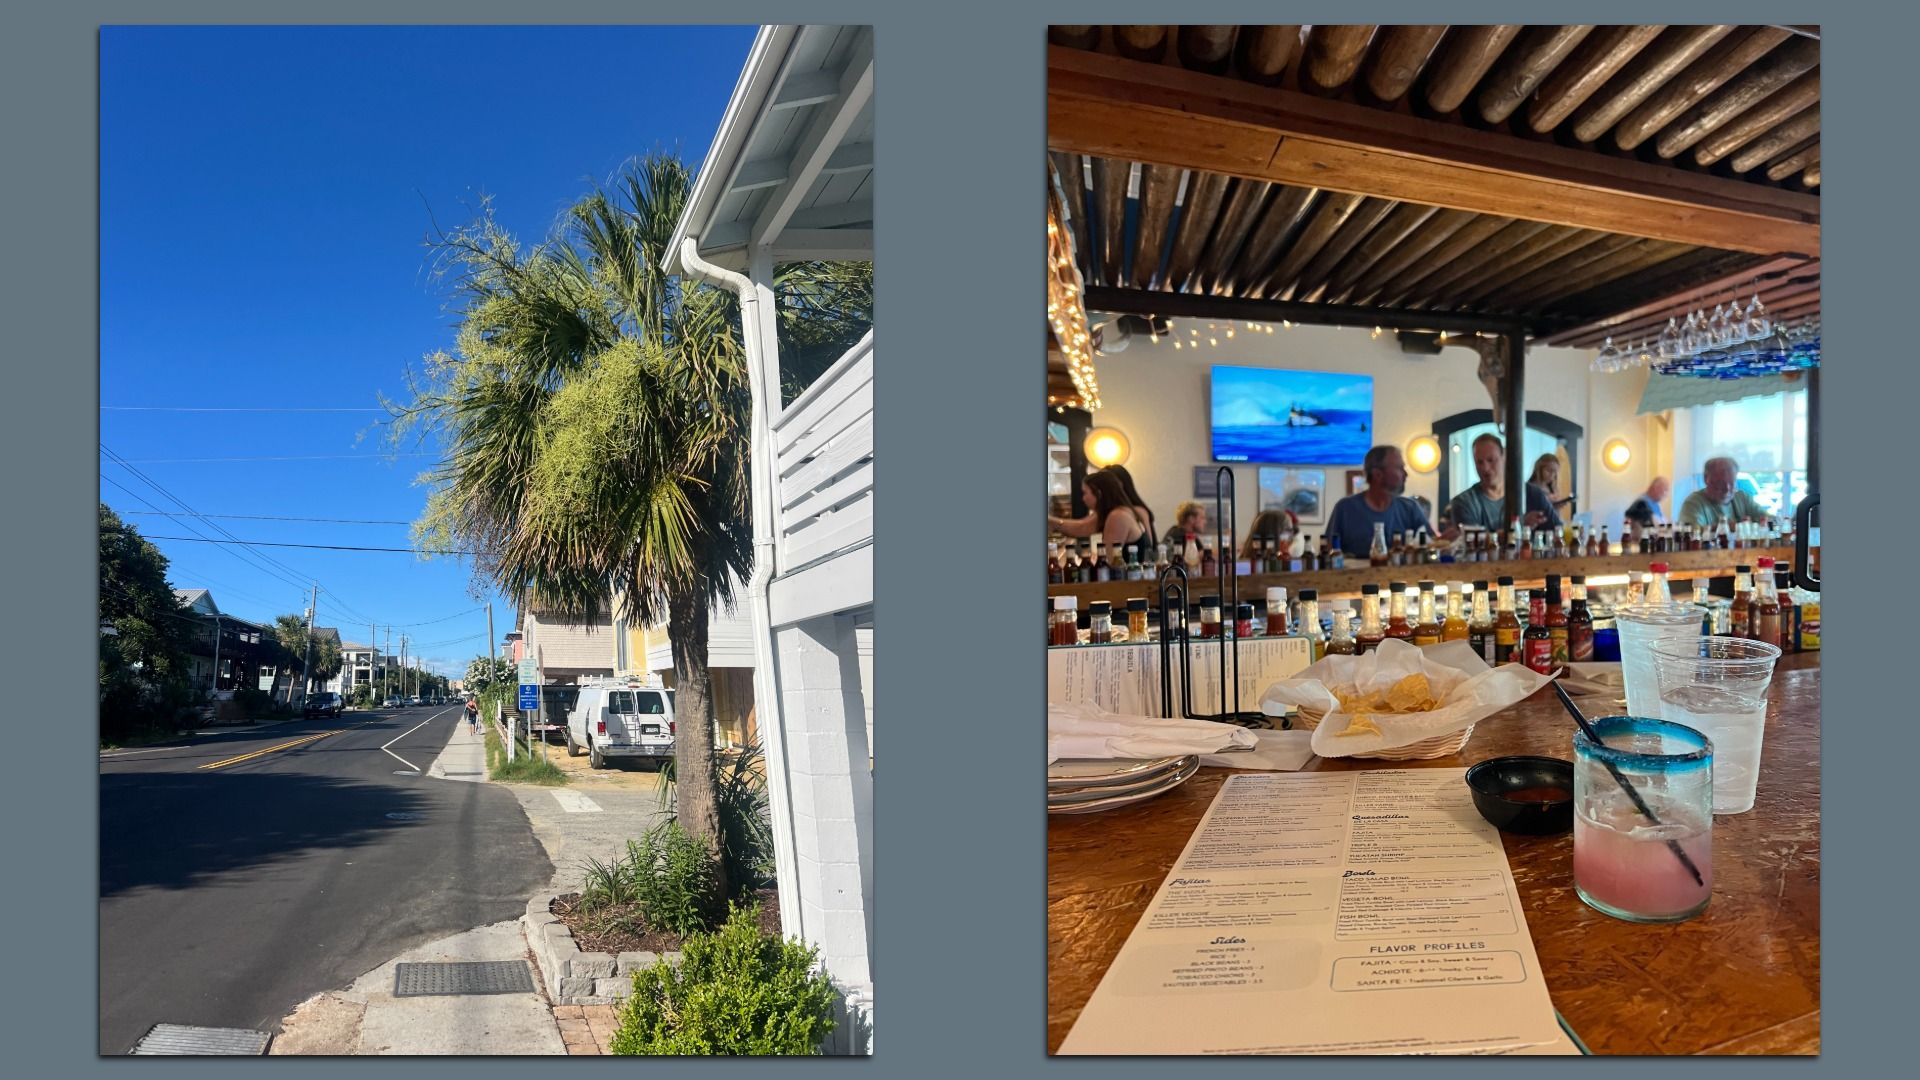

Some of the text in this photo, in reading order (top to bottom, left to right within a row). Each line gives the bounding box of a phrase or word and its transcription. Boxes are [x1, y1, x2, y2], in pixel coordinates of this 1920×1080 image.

[1169, 878, 1211, 886] Fajitas
[1210, 936, 1246, 945] Sides
[1369, 941, 1485, 954] FLAVOR PROFILES
